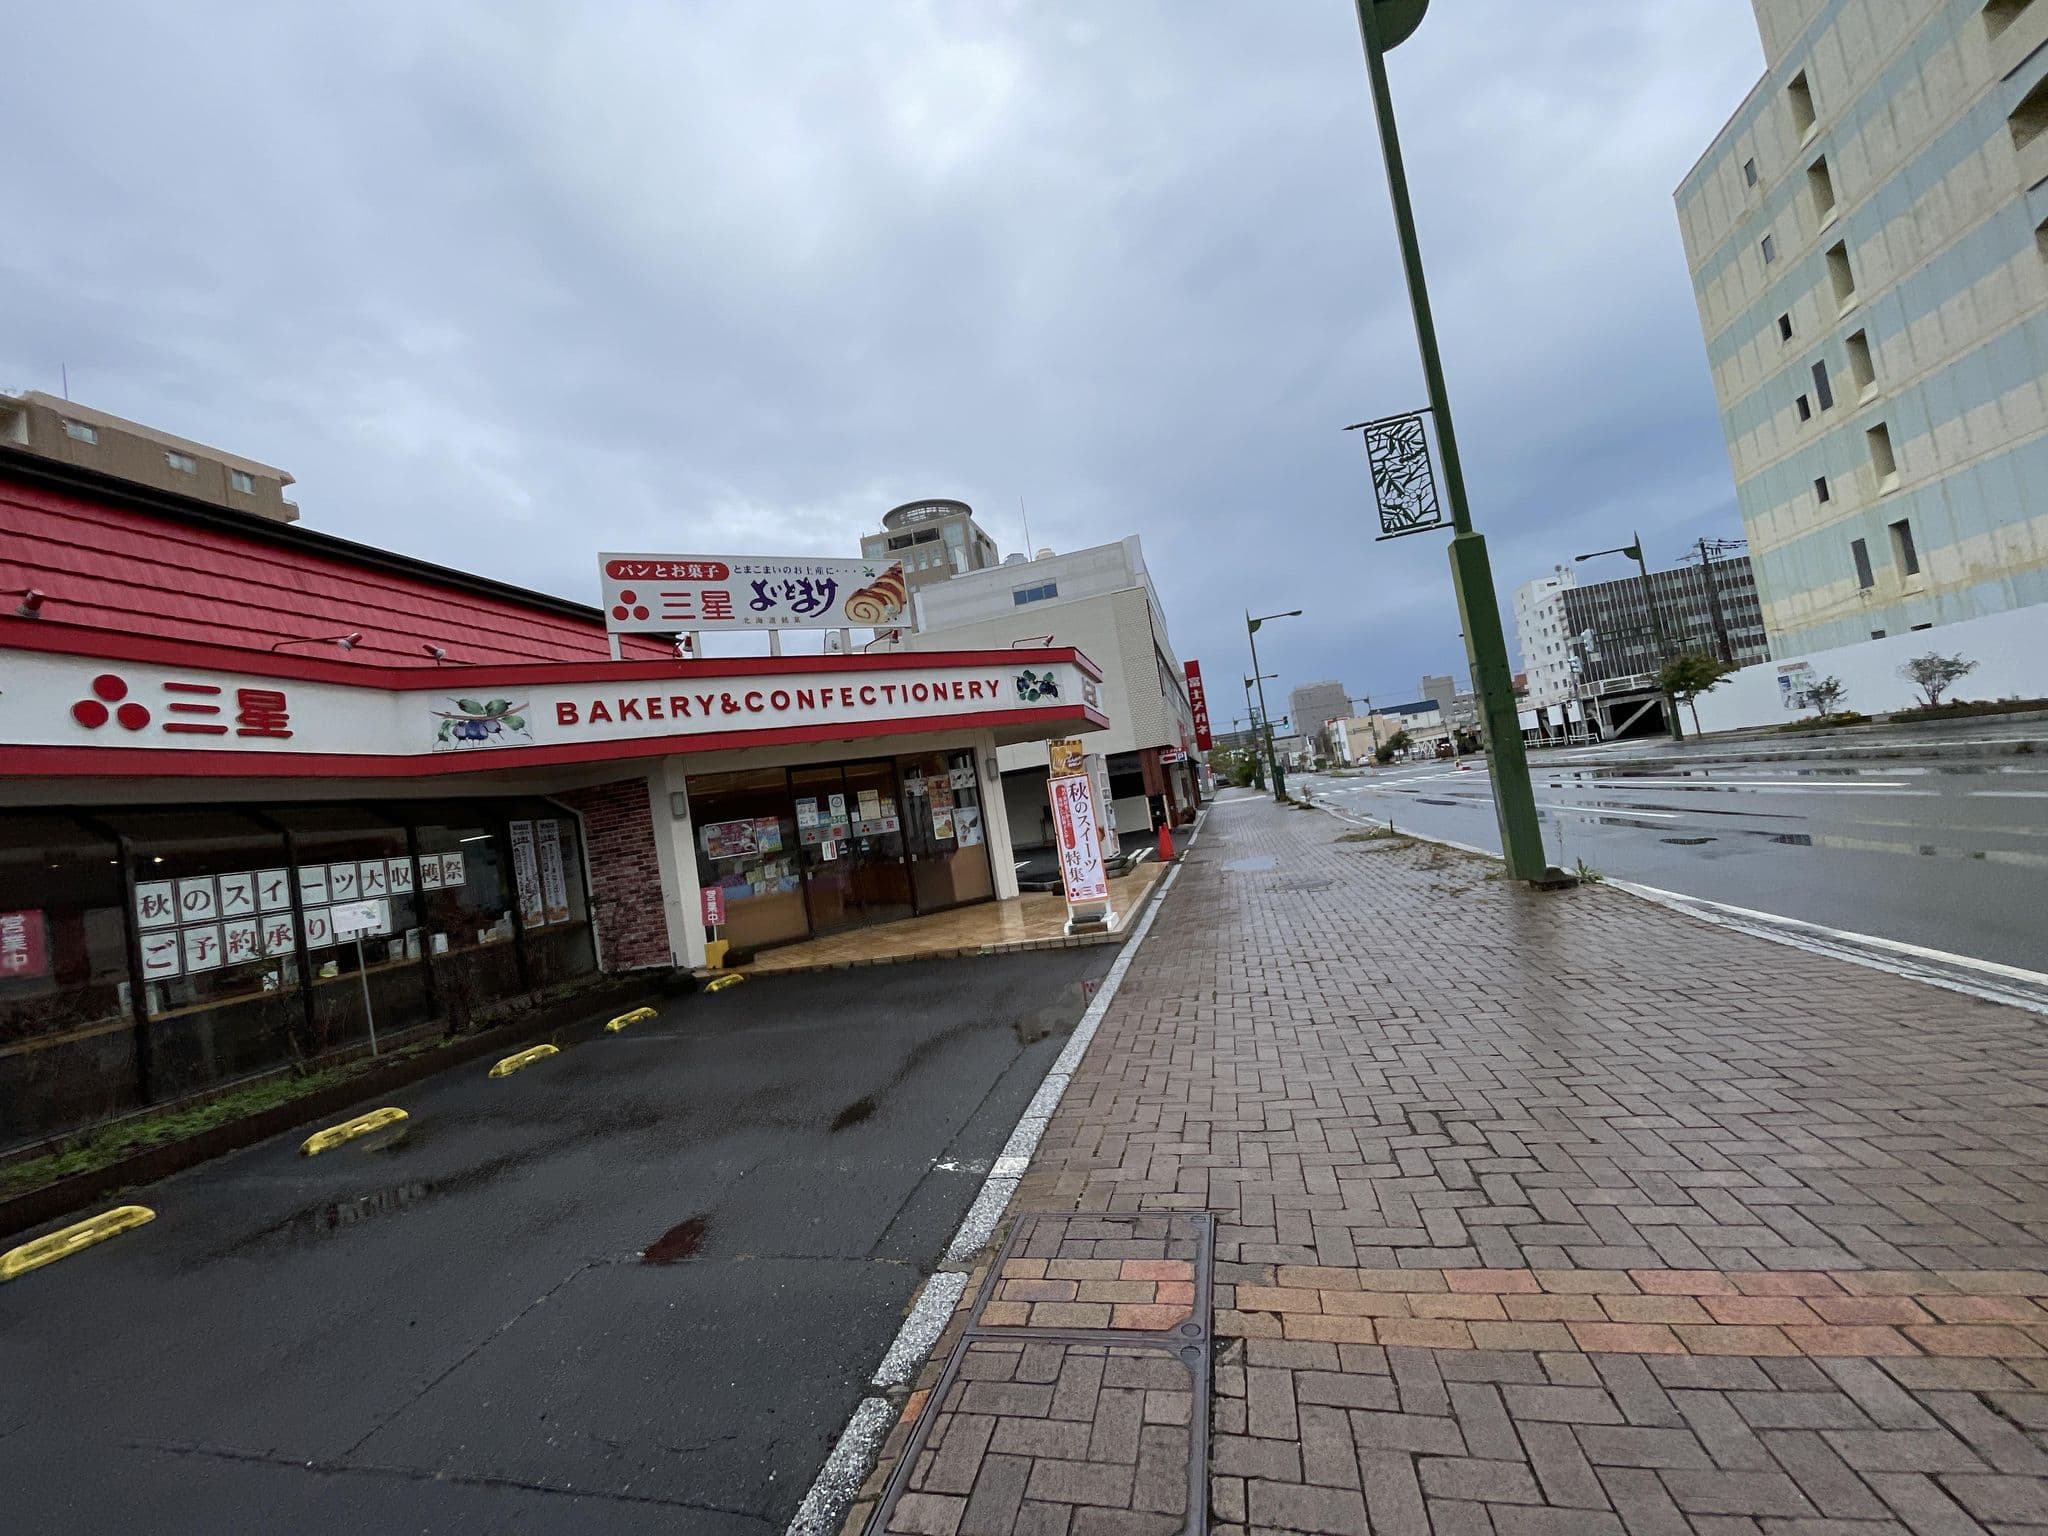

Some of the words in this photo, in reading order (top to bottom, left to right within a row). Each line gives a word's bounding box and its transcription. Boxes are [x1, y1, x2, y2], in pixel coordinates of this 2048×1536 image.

[617, 563, 721, 579] パンとお菓子
[660, 590, 735, 620] 三星
[749, 577, 838, 618] よいとまけ
[162, 682, 293, 739] 三星
[555, 679, 999, 726] BAKERY&CONFECTIONERY
[1187, 676, 1208, 735] 富士メガネ
[1177, 752, 1184, 761] P
[1069, 782, 1097, 873] 秋のスイーツ
[1065, 850, 1085, 883] 特集
[1081, 883, 1106, 895] 三星
